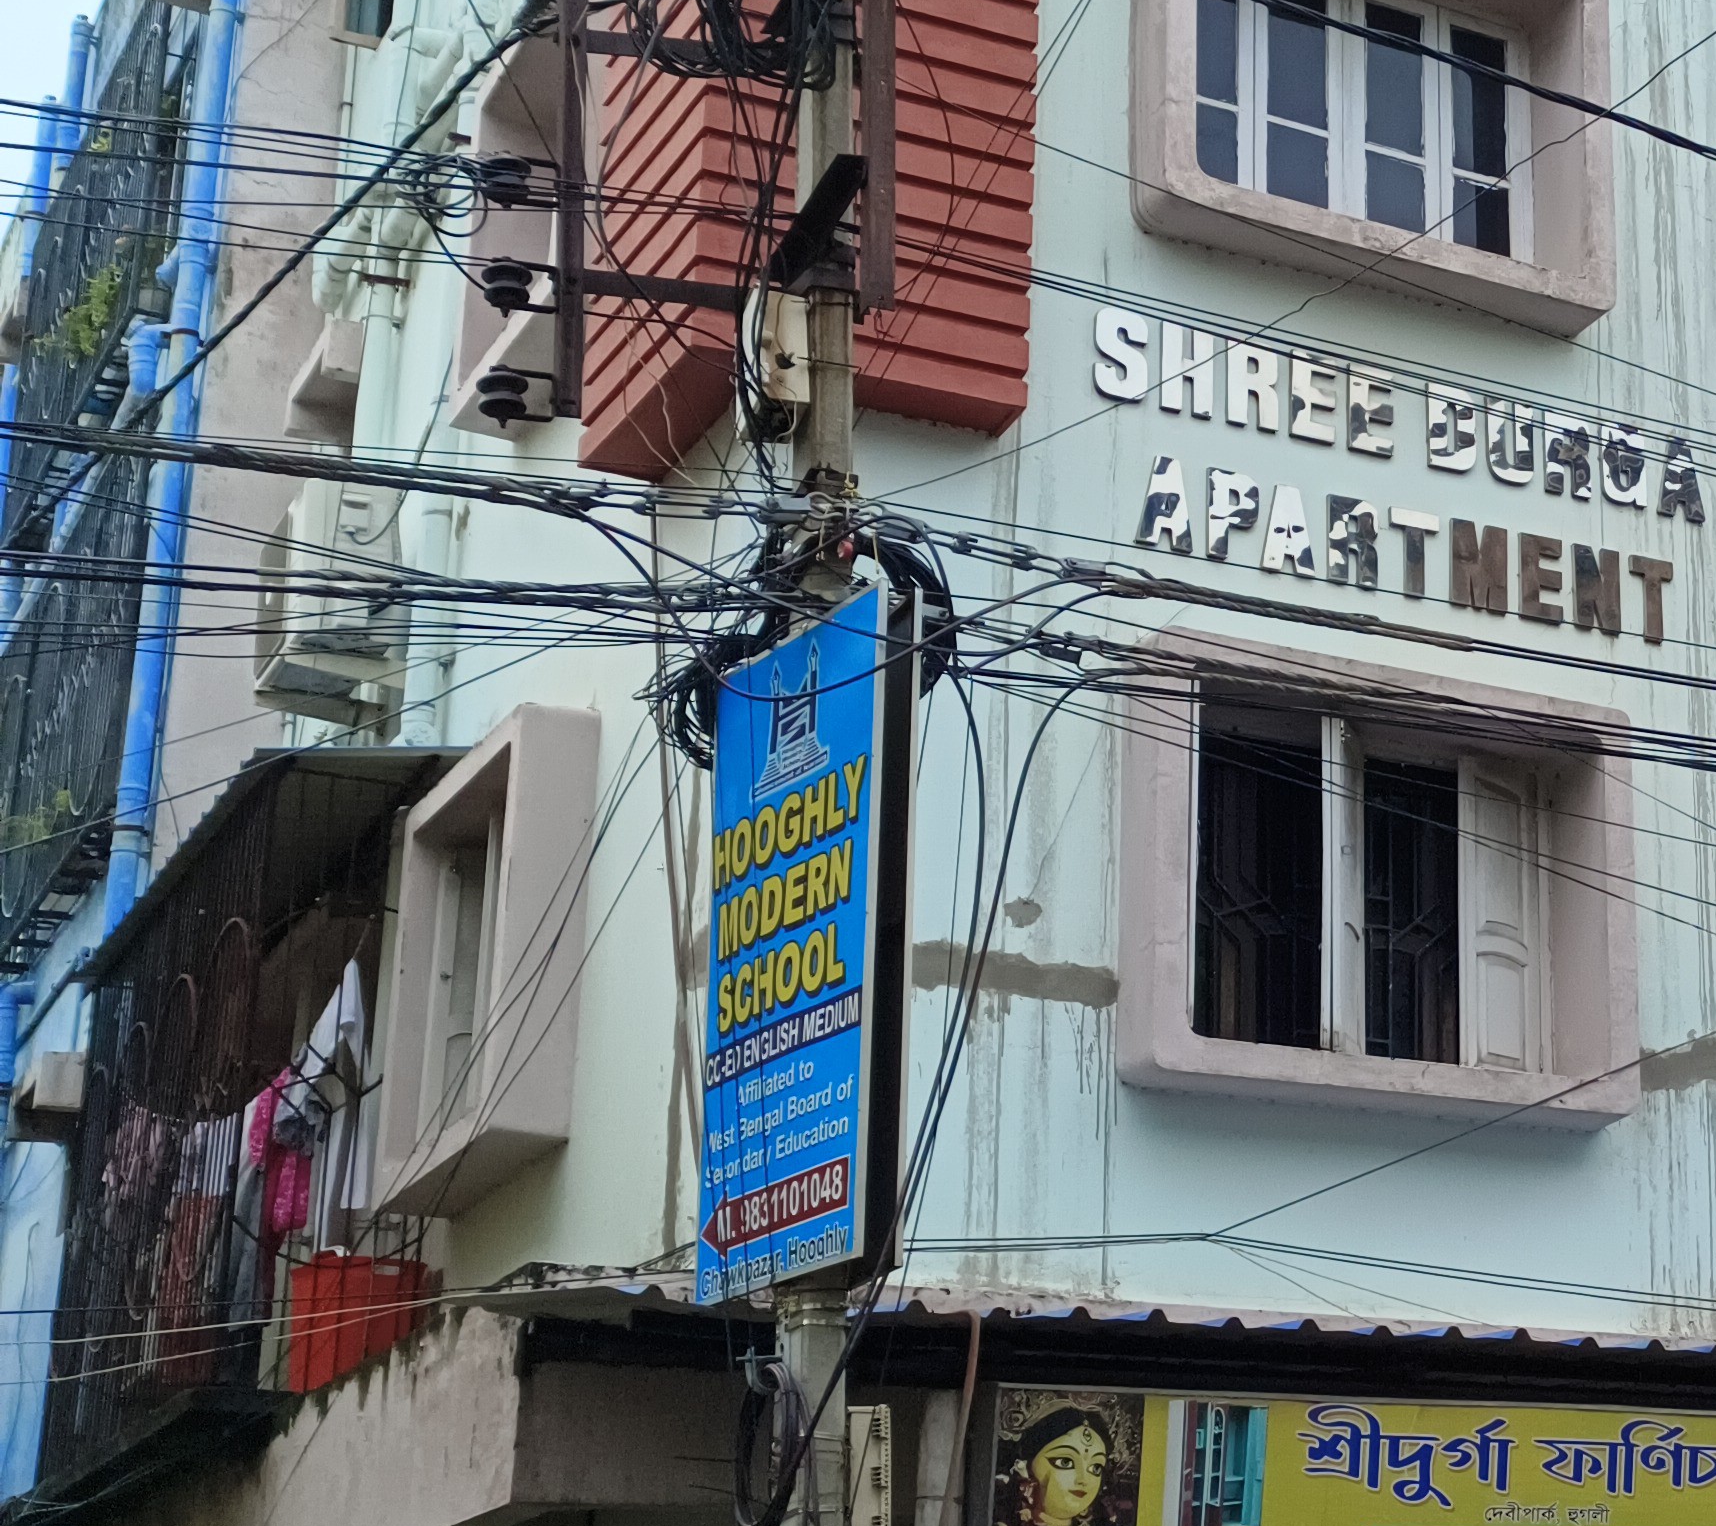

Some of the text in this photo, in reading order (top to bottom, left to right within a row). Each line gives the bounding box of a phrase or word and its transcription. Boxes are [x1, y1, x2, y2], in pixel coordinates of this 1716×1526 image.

[1093, 306, 1706, 524] SHREE DURGA
[1133, 454, 1674, 645] APARTMENT
[714, 754, 867, 890] HOOGHLY
[718, 839, 851, 961] MODERN
[718, 923, 844, 1033] SCHOOL
[743, 1018, 799, 1068] ENGLISH
[803, 992, 859, 1042] MEDIUM
[738, 1060, 814, 1107] Affiliated to
[740, 1100, 783, 1141] Bengal
[787, 1081, 832, 1120] Board
[836, 1073, 855, 1102] of
[775, 1116, 849, 1160] Education
[741, 1164, 842, 1234] 9831101048
[787, 1222, 849, 1270] Hooghly
[1567, 1503, 1610, 1525] হুগলী
